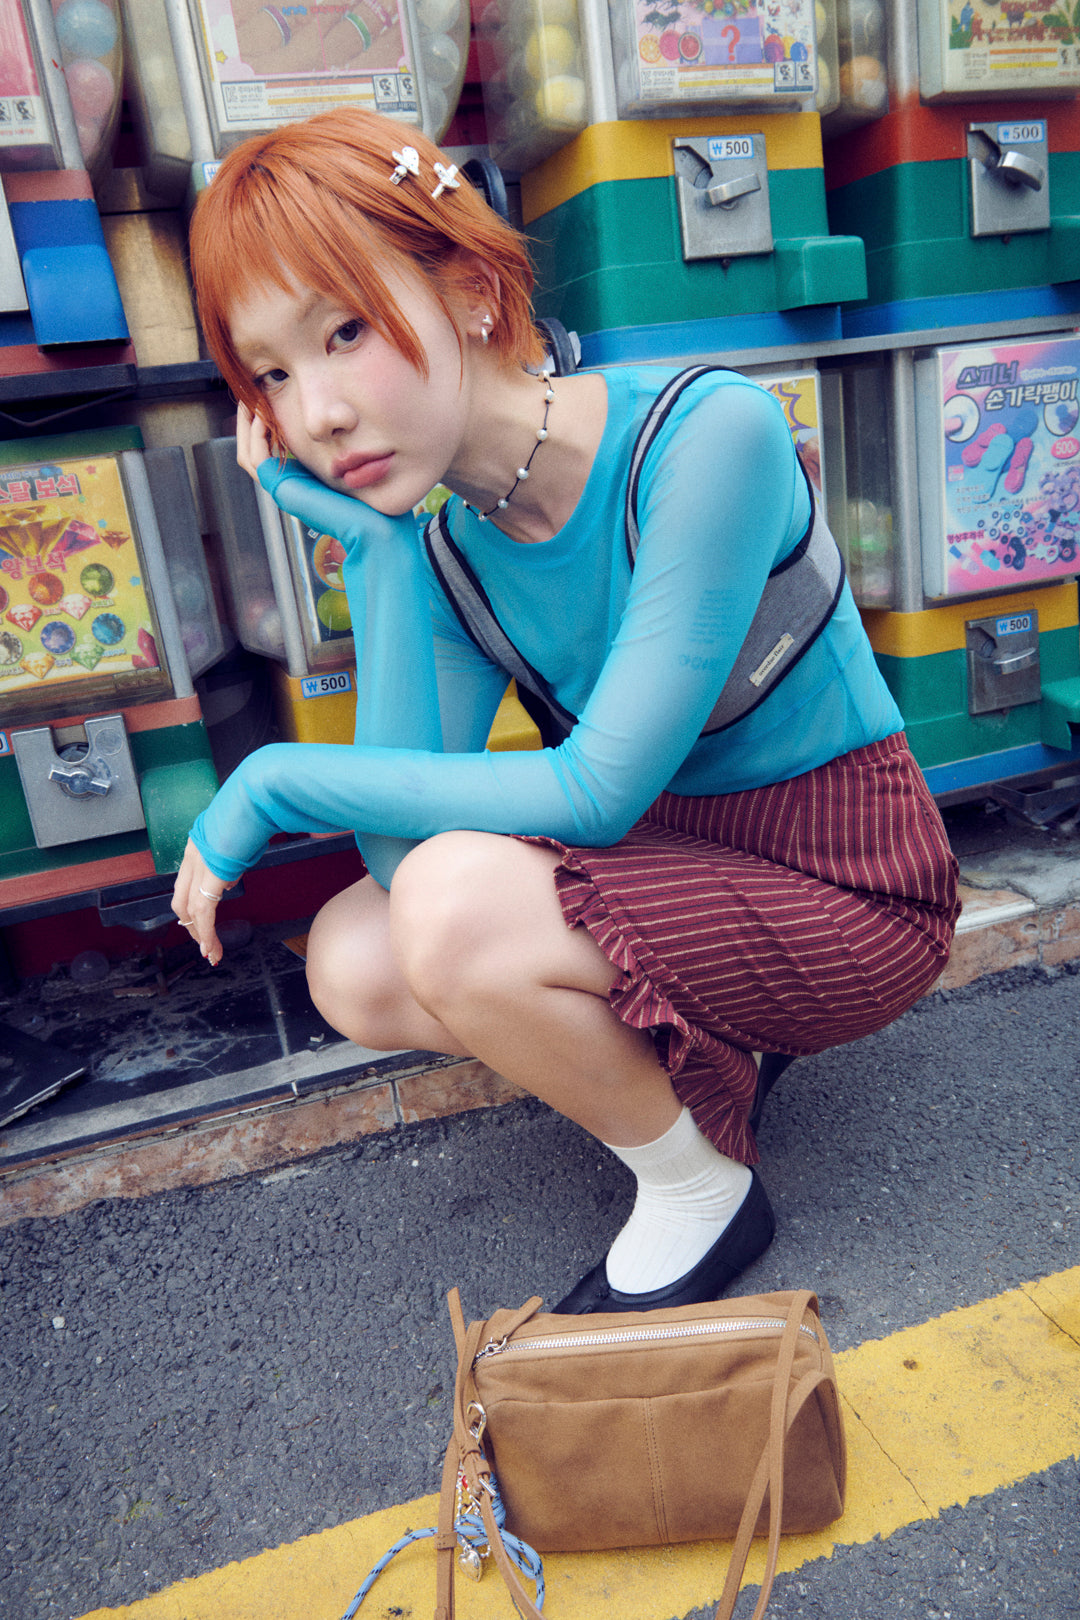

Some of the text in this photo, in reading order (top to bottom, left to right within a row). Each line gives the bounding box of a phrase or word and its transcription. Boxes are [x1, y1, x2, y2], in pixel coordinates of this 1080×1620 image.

[957, 360, 1019, 389] 스피너
[985, 378, 1079, 411] 손가락팽이
[35, 474, 79, 500] 보석
[1, 550, 67, 580] 왕보석
